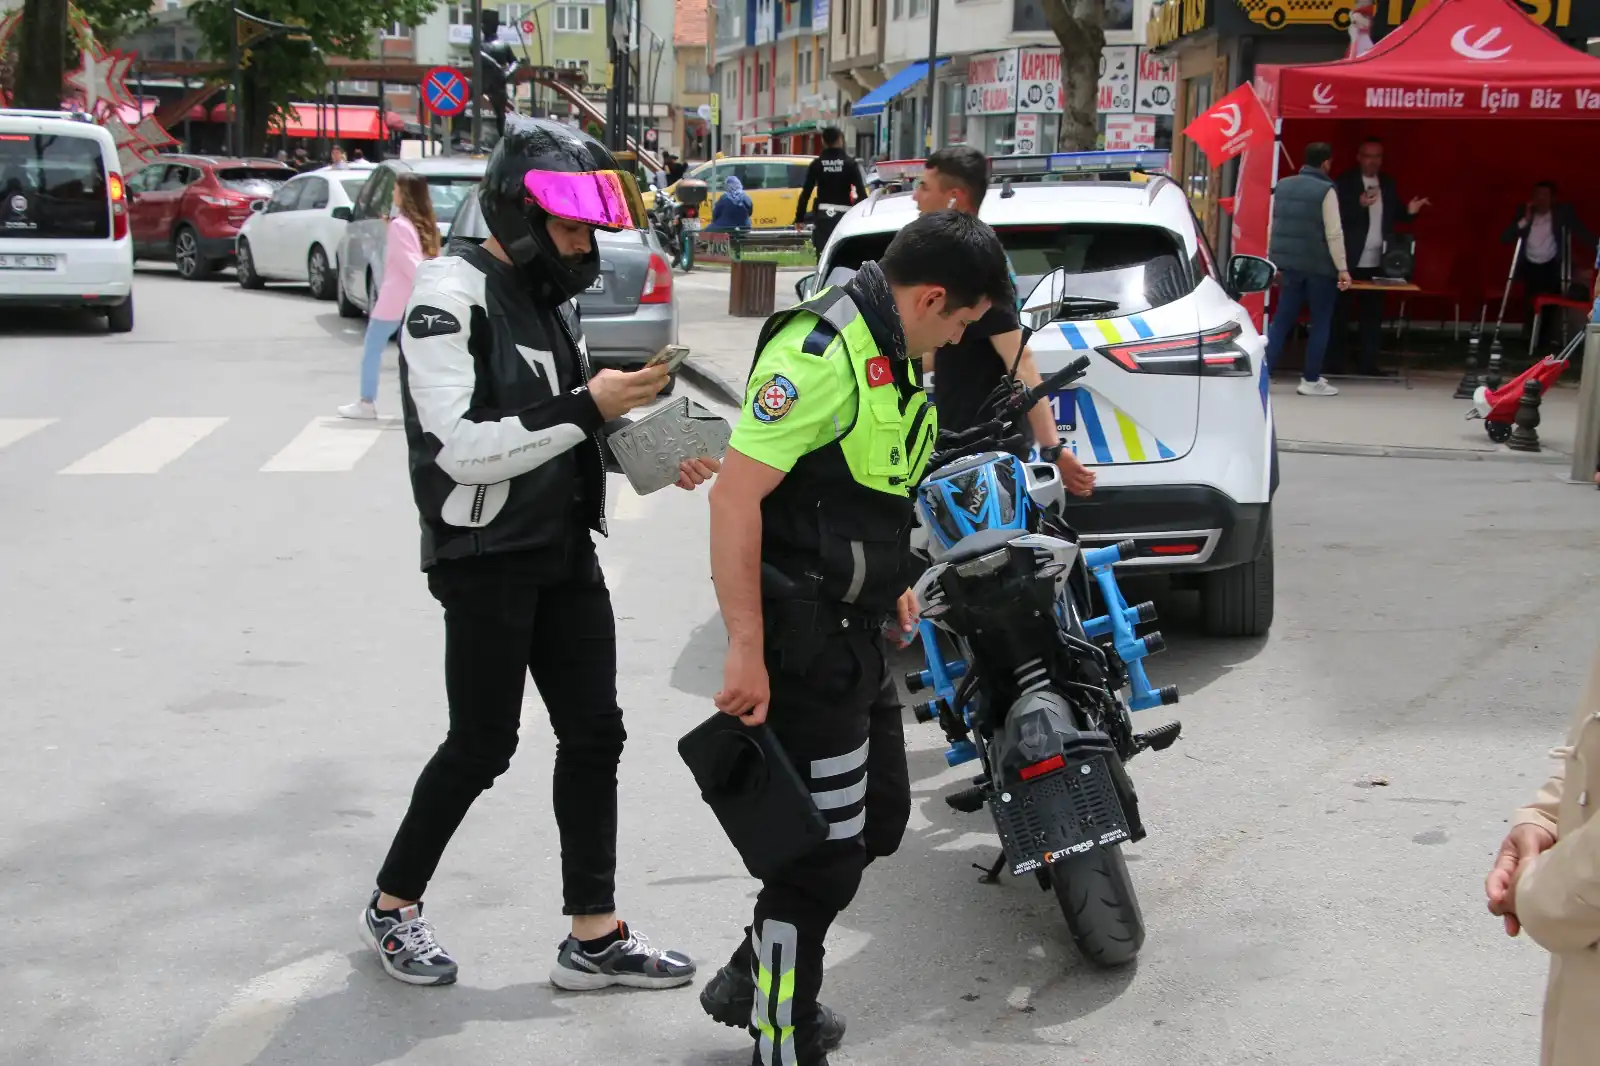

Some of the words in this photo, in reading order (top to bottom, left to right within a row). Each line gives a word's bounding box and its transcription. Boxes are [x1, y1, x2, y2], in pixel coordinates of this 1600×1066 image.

[1365, 87, 1465, 109] Milletimiz
[1480, 83, 1520, 113] İçin
[1530, 88, 1563, 109] Biz
[1575, 89, 1600, 109] Va
[508, 436, 552, 458] PRO
